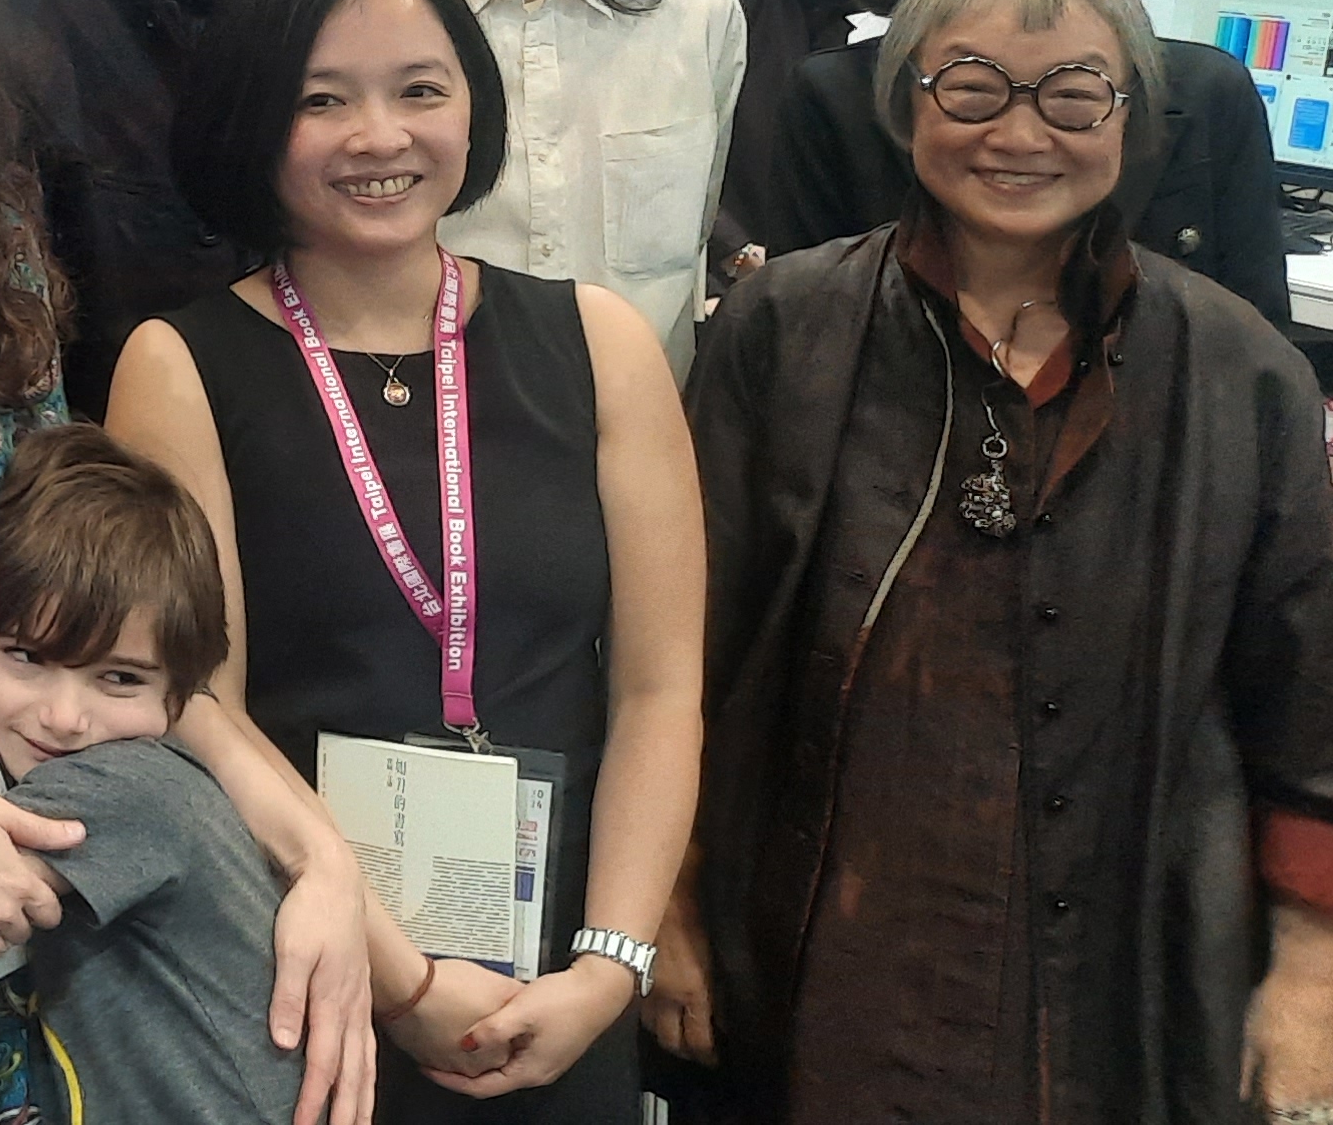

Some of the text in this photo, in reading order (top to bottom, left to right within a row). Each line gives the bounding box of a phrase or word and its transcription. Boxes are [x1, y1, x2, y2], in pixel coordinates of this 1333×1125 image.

[291, 307, 321, 349] Book
[309, 351, 367, 465] International
[356, 464, 390, 521] Taipei
[438, 338, 468, 672] Taipei International Book Exhibition
